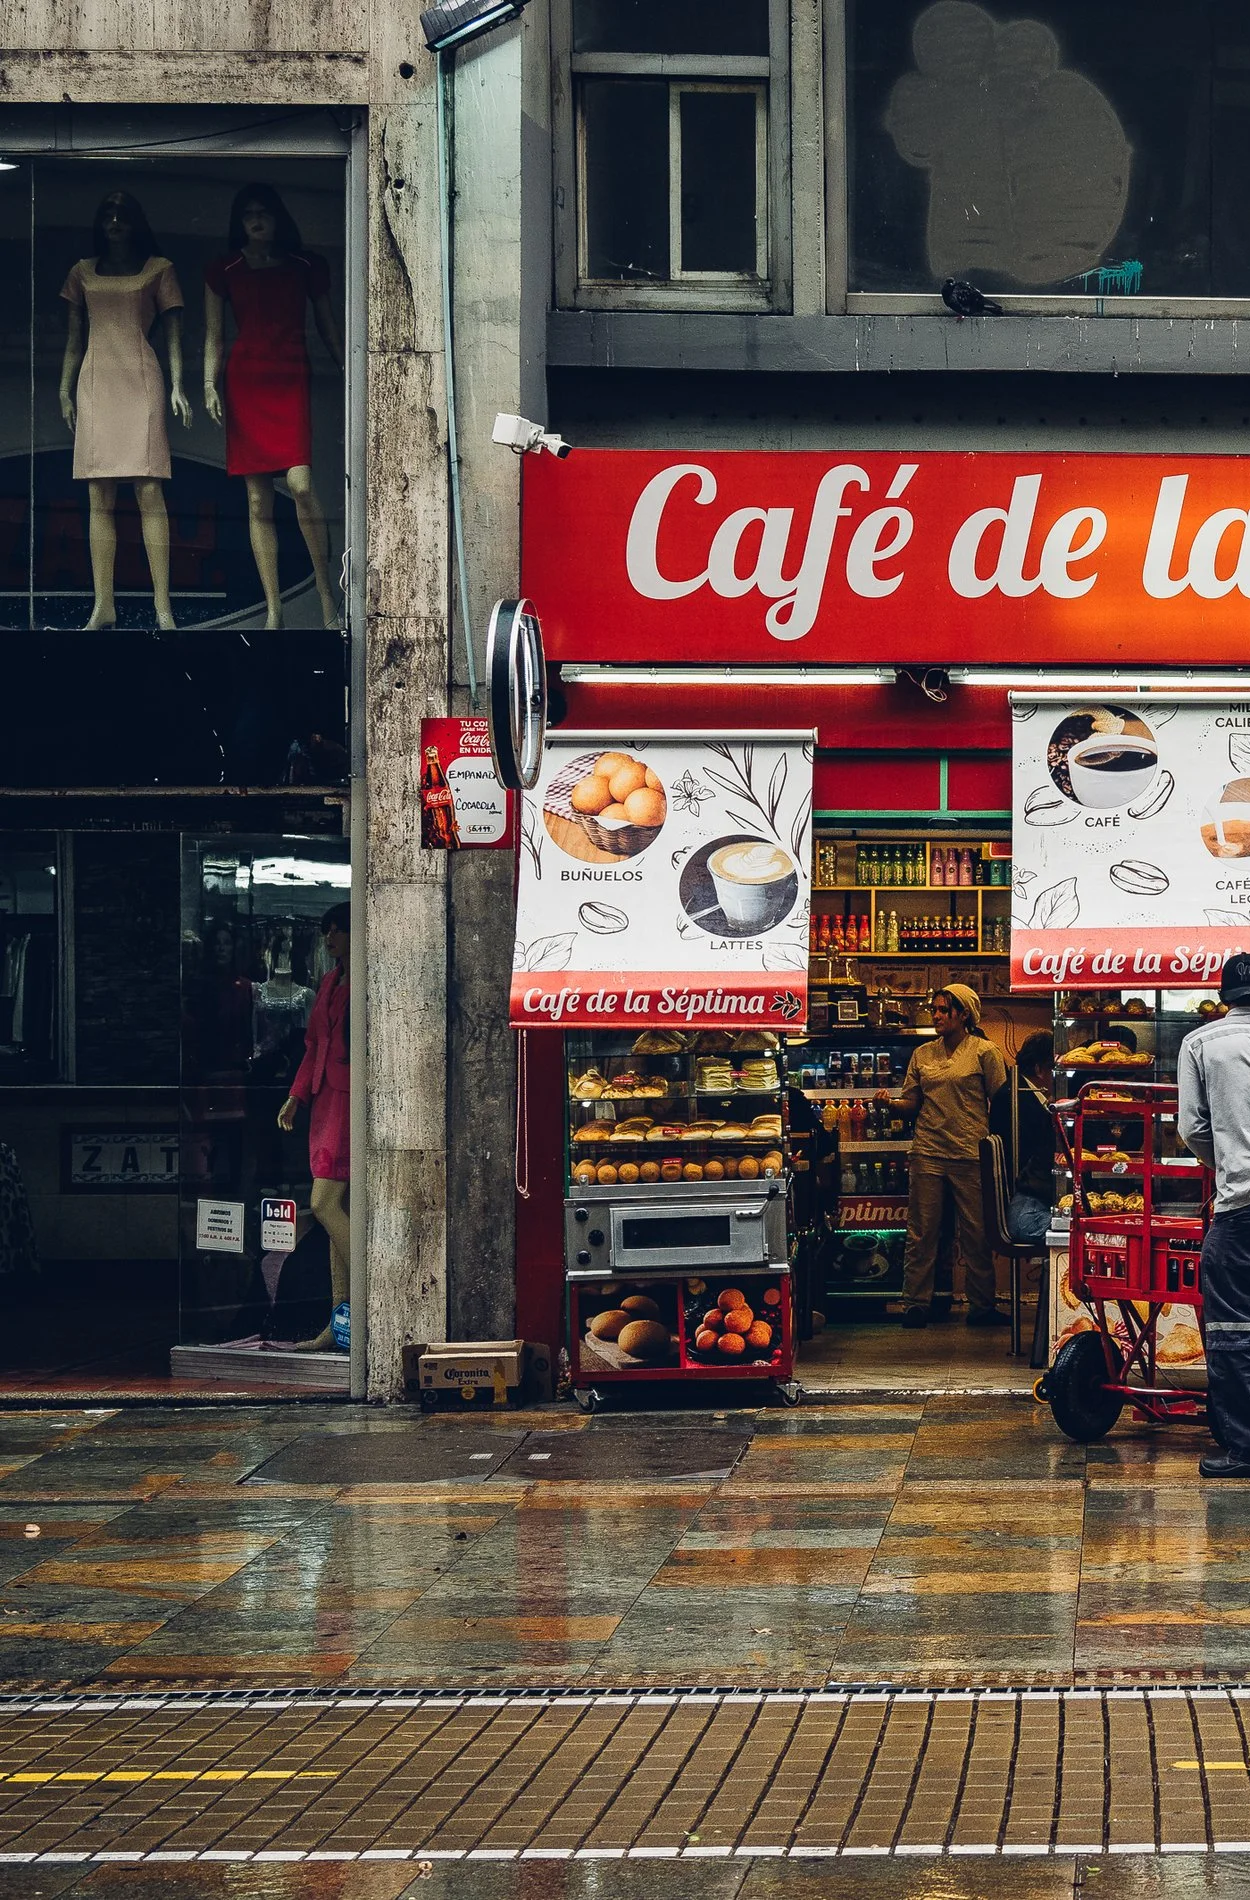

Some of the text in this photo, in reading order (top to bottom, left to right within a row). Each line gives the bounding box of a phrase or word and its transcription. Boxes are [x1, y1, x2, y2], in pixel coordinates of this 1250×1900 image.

[627, 464, 919, 640] Café
[949, 474, 1107, 598] de
[1085, 814, 1120, 828] CAFÉ
[561, 870, 643, 882] BUÑUELOS
[1215, 877, 1250, 891] CAFÉ
[710, 940, 763, 950] LATTES
[1021, 946, 1086, 983] Café
[1091, 946, 1127, 975] de
[1133, 947, 1162, 974] la
[522, 986, 765, 1022] Café de la Séptima
[266, 1203, 291, 1219] bold
[444, 1368, 490, 1380] Coronita
